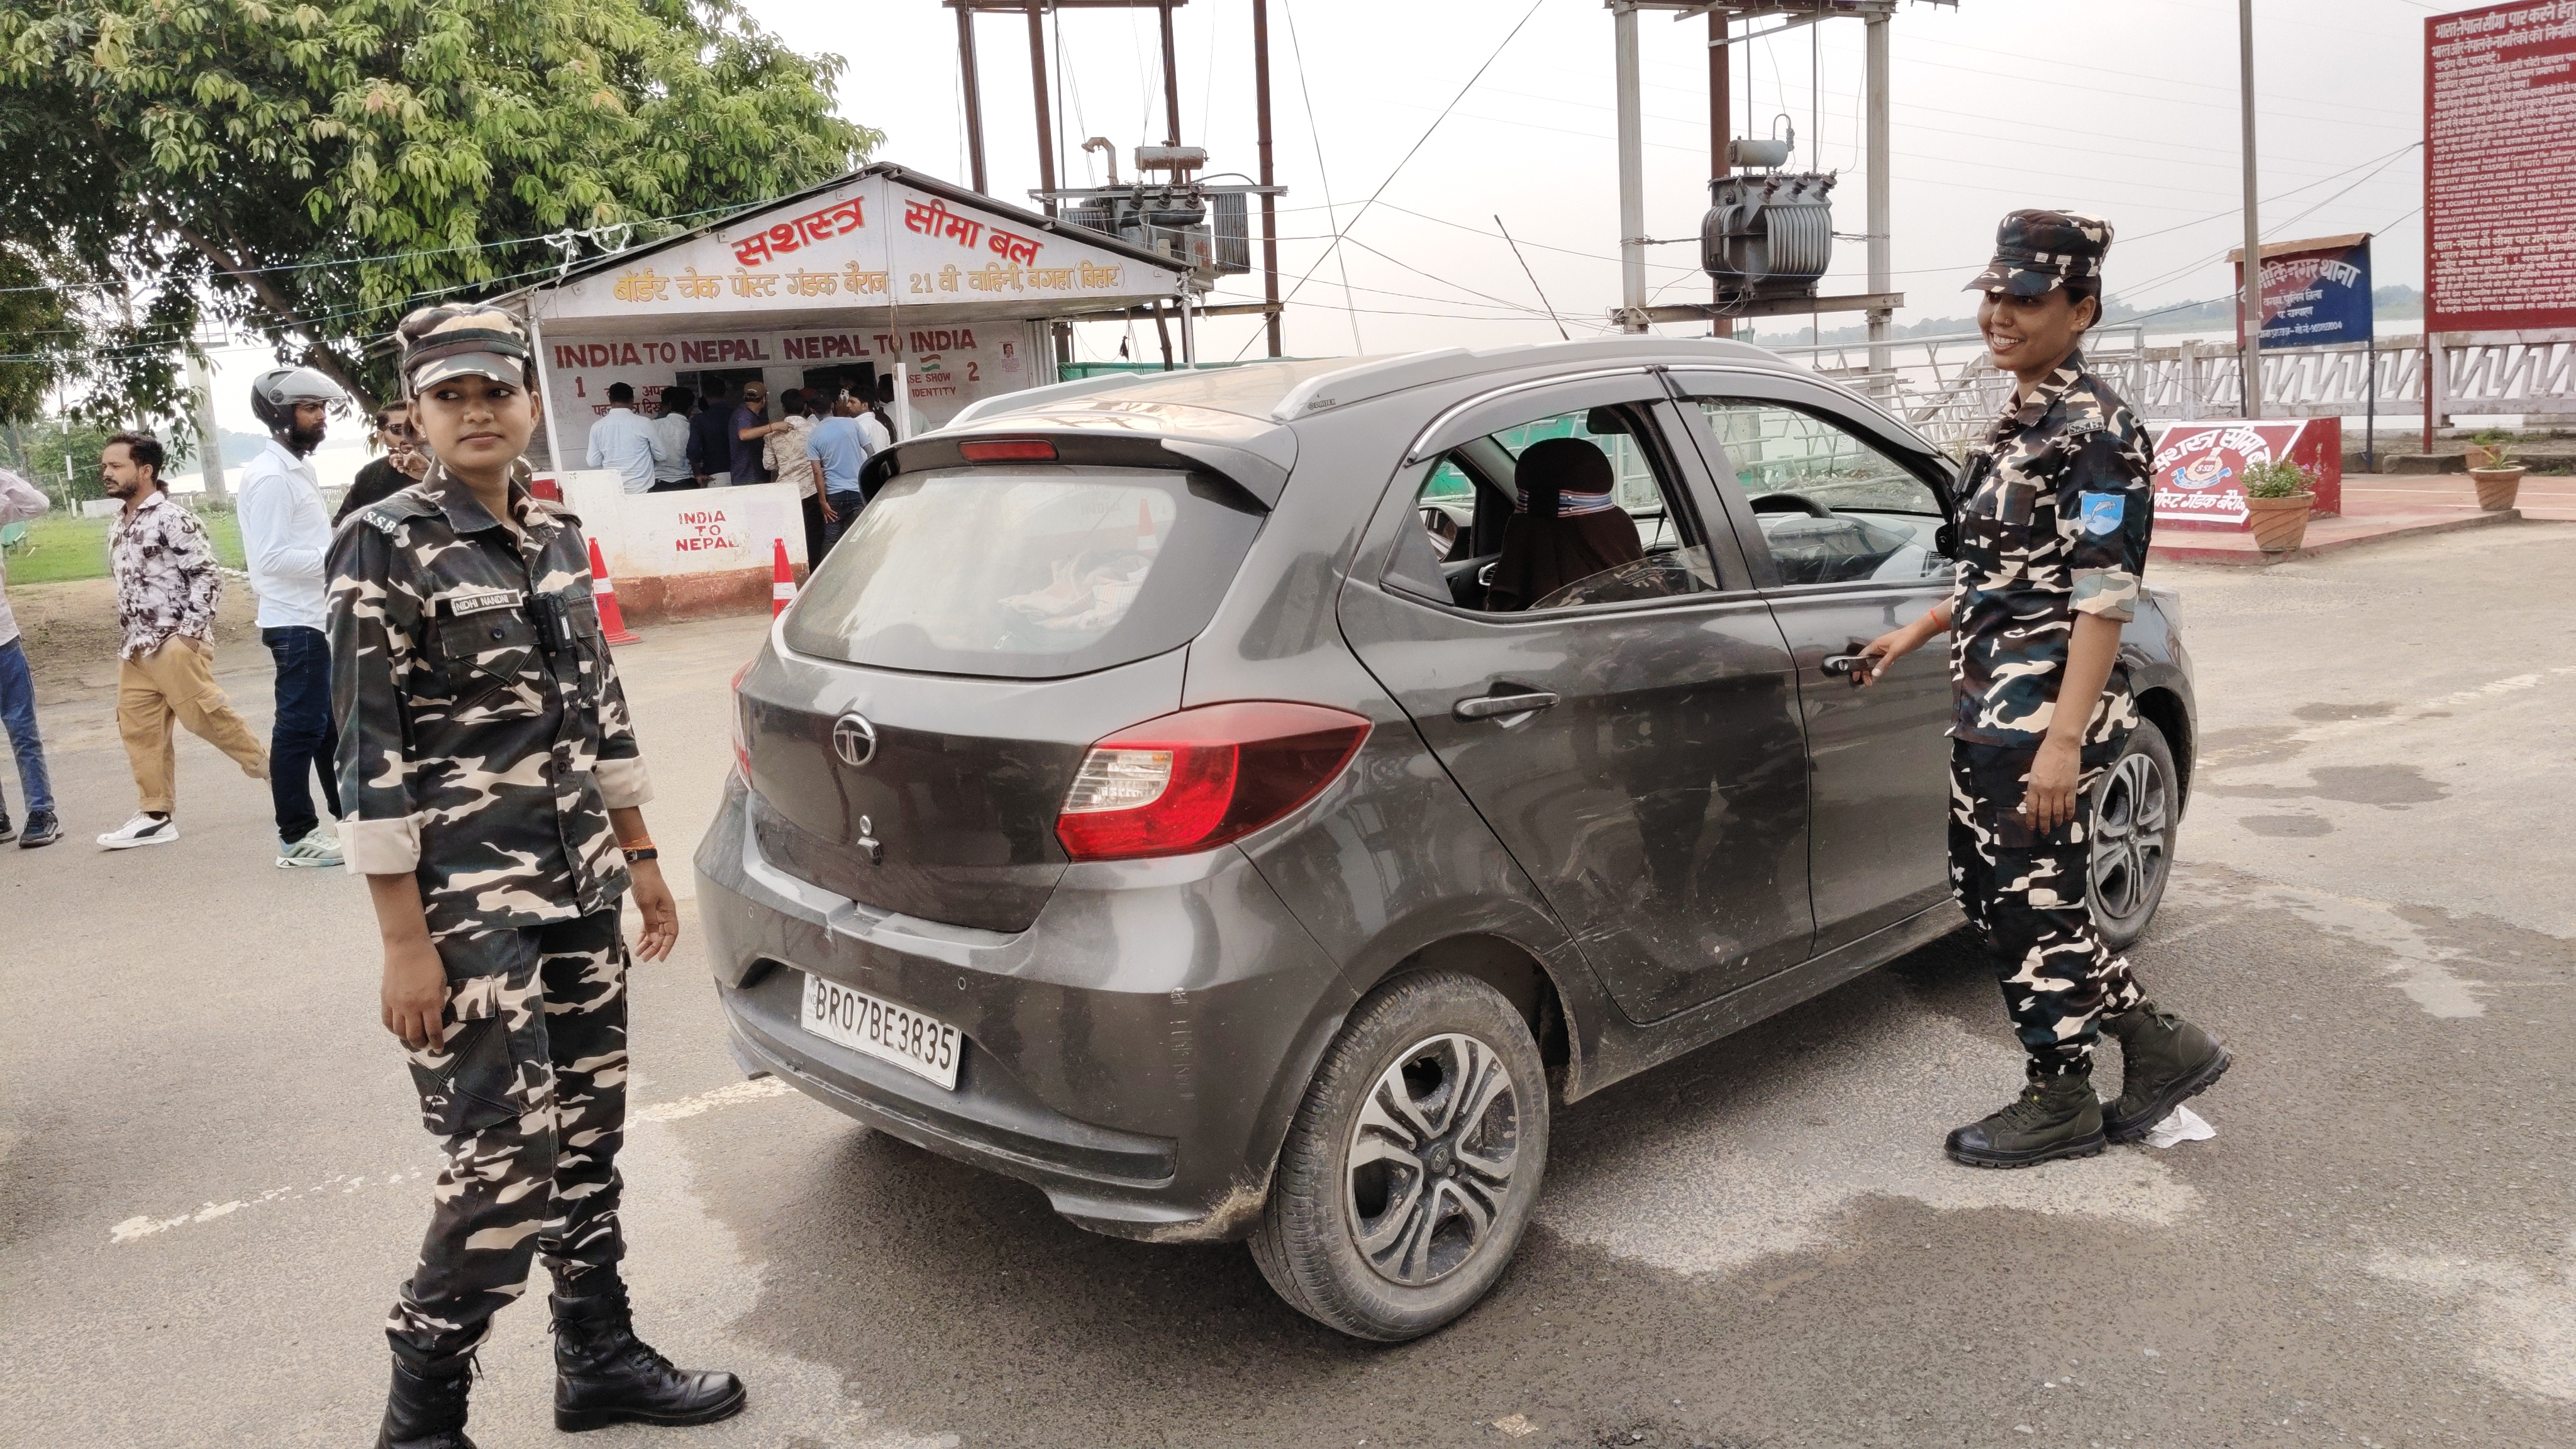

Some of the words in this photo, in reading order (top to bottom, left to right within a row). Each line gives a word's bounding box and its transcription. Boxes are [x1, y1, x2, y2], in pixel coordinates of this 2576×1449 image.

[2482, 11, 2506, 31] सीमा
[2508, 9, 2528, 26] पार
[2528, 1, 2556, 23] करने
[2431, 44, 2451, 57] भारत
[2450, 38, 2465, 55] और
[2463, 37, 2485, 52] नेपाल
[2453, 150, 2485, 158] DOCUMENTS
[2497, 144, 2538, 153] IDENTIFICATION
[2451, 166, 2479, 174] NATIONAL
[2481, 162, 2510, 170] PASSPORT
[2543, 156, 2571, 165] IDENTITY
[2434, 177, 2459, 185] IDENTITY
[2461, 173, 2494, 182] CERTIFICATE
[2446, 183, 2473, 191] CHILDREN
[2475, 179, 2516, 188] ACCOMPANIED
[2527, 175, 2555, 183] PARENTS
[2446, 199, 2478, 207] DOCUMENT
[2494, 194, 2524, 203] CHILDREN
[730, 196, 865, 267] सशस्त्र
[904, 199, 985, 250] सीमा
[988, 226, 1044, 268] बल
[2434, 231, 2479, 239] REQUIREMENT
[2492, 226, 2536, 235] IMMIGRATION
[2492, 235, 2514, 245] सीमा
[2514, 235, 2530, 243] पार
[2460, 248, 2479, 257] नेपाल
[613, 267, 670, 303] बॉर्डर
[674, 267, 723, 299] चेक
[728, 267, 780, 298] पोस्ट
[786, 267, 838, 297] गंडक
[842, 260, 888, 297] बैराज
[909, 273, 933, 294] 21
[939, 264, 962, 293] वी
[2319, 259, 2361, 288] थाना
[782, 334, 870, 360] NEPAL
[909, 329, 977, 353] INDIA
[554, 343, 643, 369] INDIA
[643, 342, 676, 364] TO
[681, 339, 770, 364] NEPAL
[926, 372, 950, 382] SHOW
[967, 362, 980, 382] 2
[575, 376, 586, 397] 1
[911, 386, 956, 398] IDENTITY
[2219, 426, 2267, 457] सीमा
[2180, 491, 2221, 509] गंडक
[678, 510, 726, 525] INDIA
[694, 524, 721, 536] TO
[675, 536, 740, 552] NEPAL
[455, 598, 478, 611] NIDHI
[480, 594, 509, 606] NANDNI
[816, 982, 955, 1070] BR07BE3835
